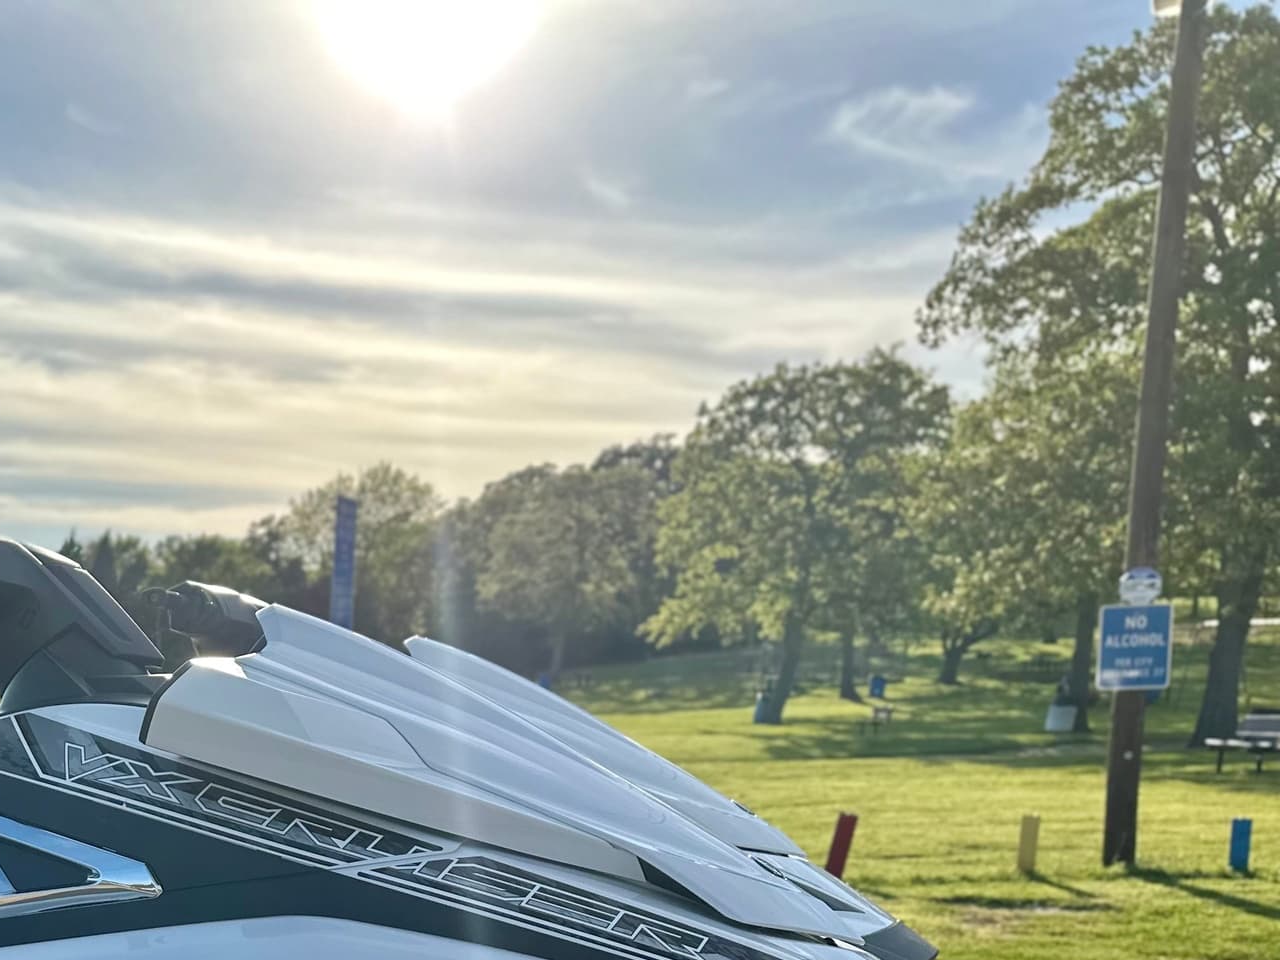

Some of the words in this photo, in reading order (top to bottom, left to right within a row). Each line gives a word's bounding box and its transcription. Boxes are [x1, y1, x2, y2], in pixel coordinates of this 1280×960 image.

[1124, 615, 1148, 630] NO
[1104, 632, 1166, 648] ALCOHOL
[64, 742, 203, 805] VX
